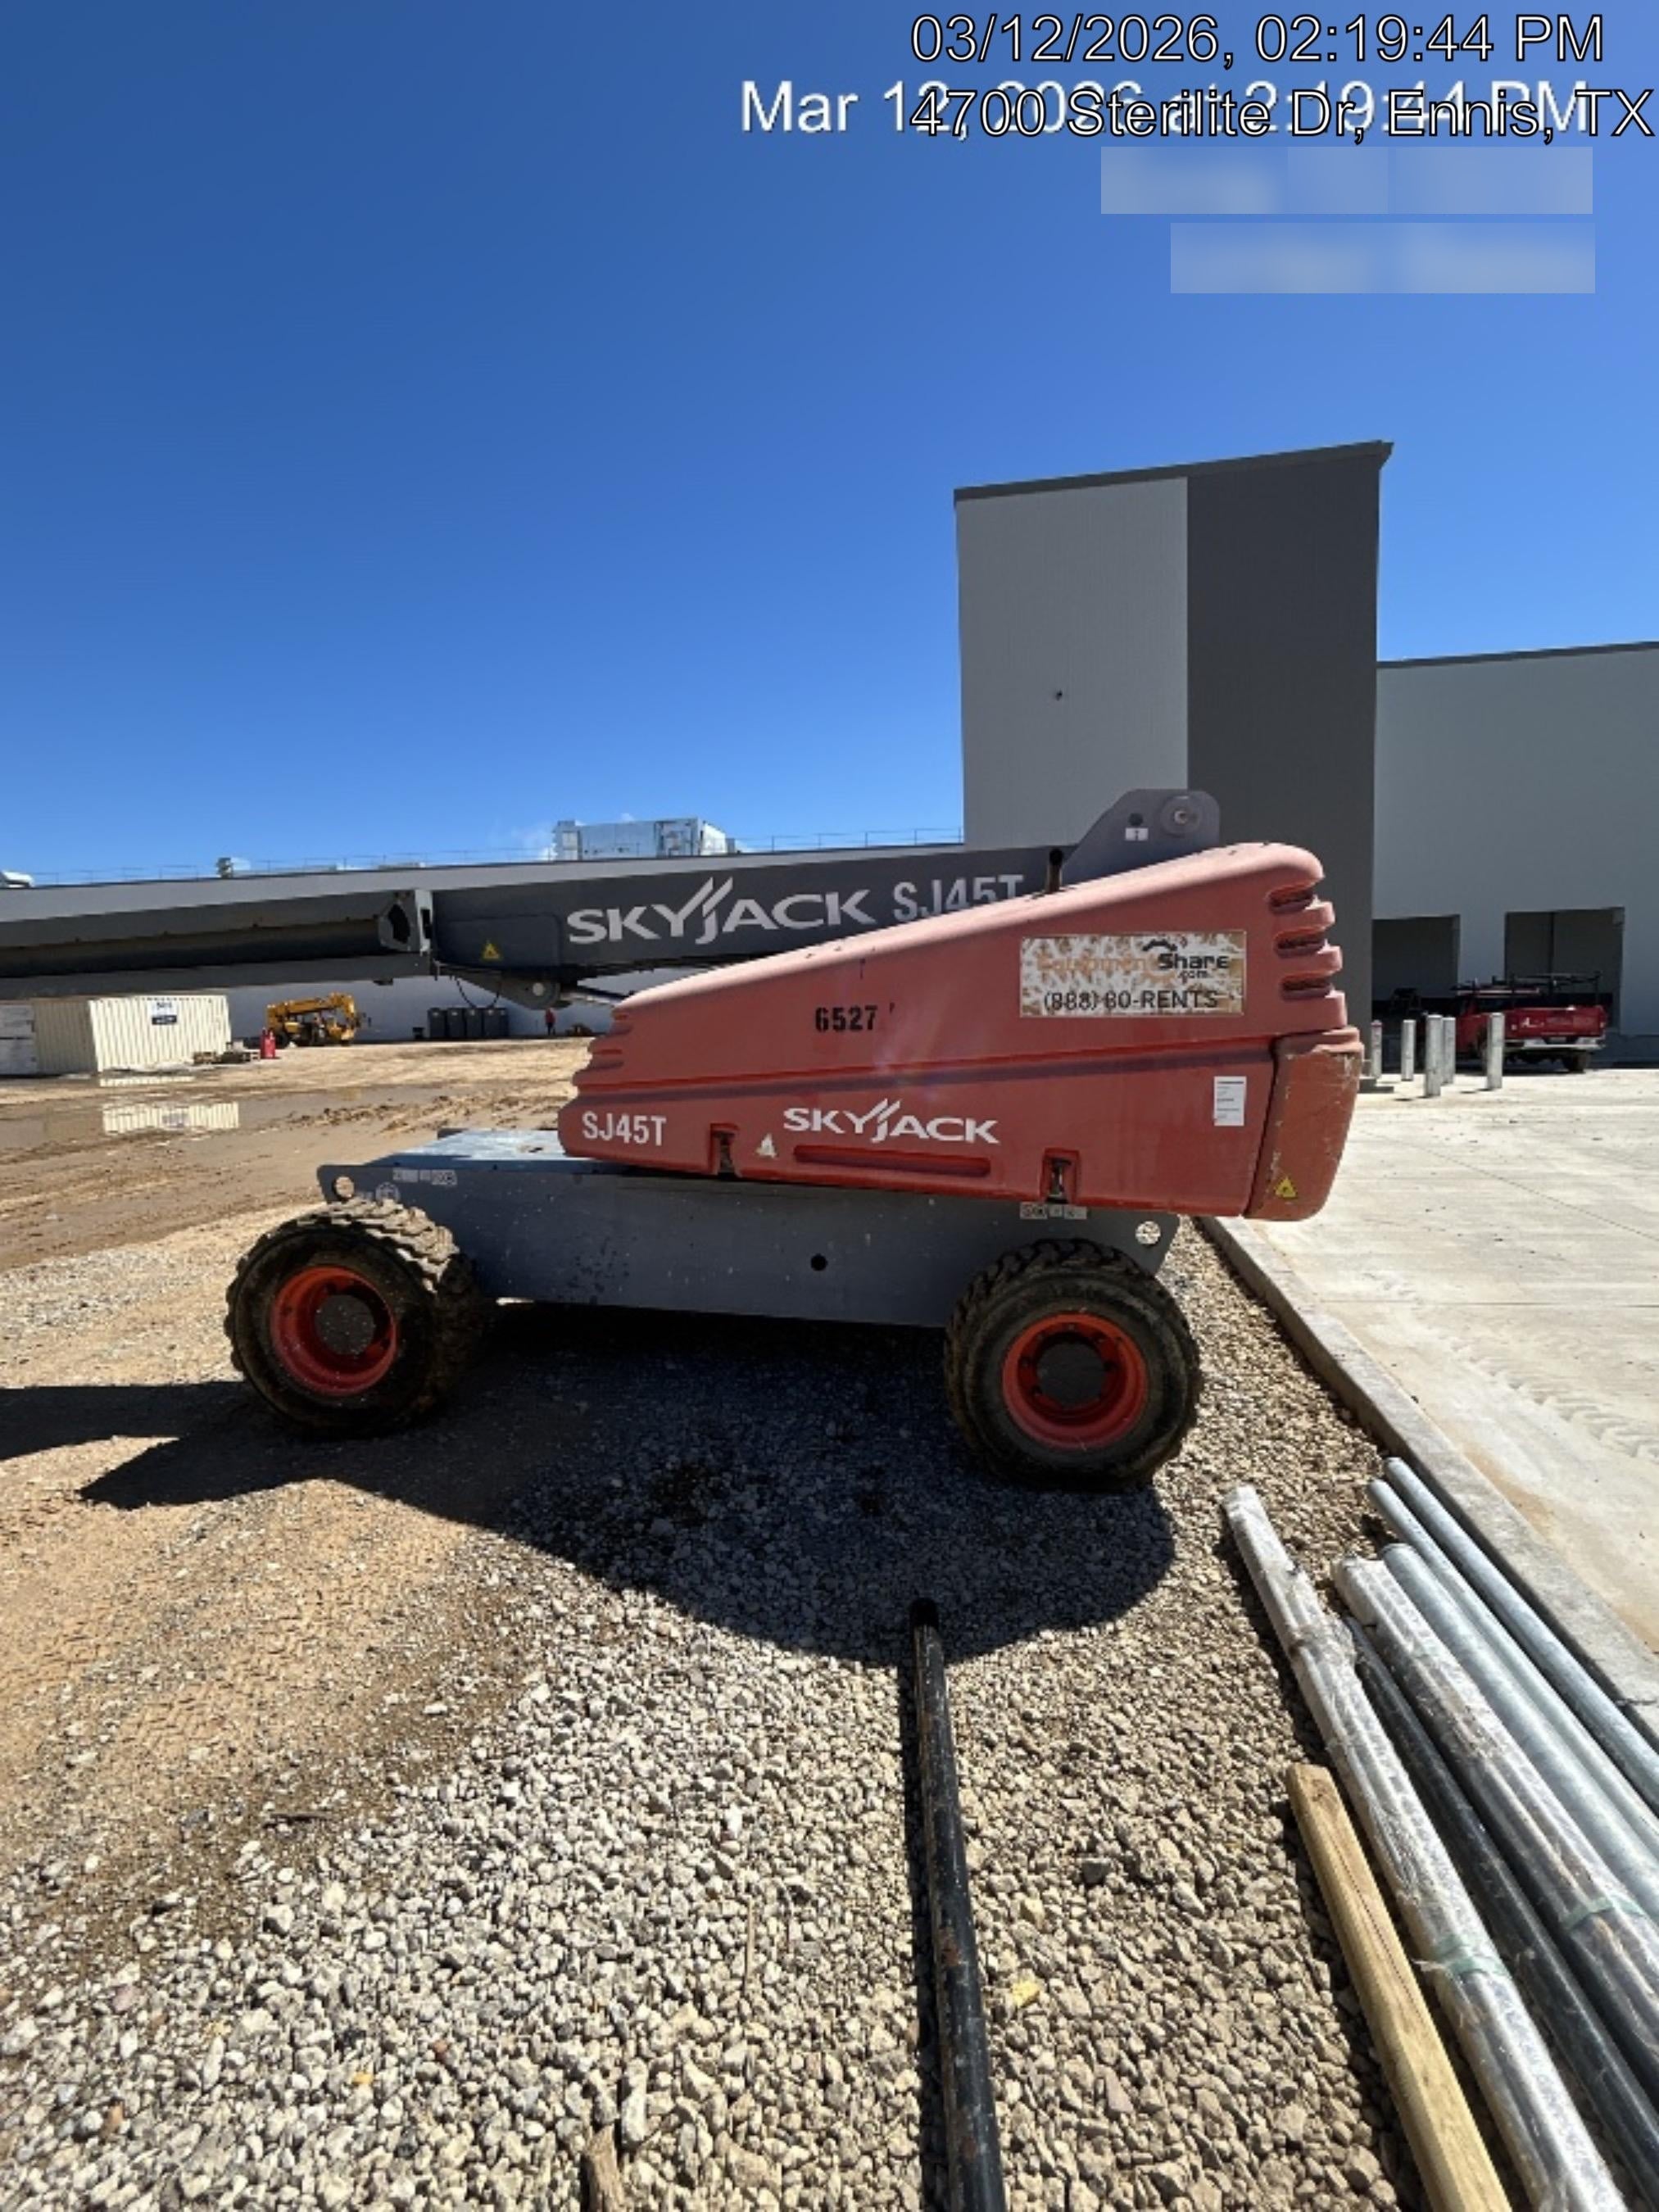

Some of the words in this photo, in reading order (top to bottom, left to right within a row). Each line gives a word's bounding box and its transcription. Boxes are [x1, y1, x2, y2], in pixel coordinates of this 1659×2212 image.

[566, 877, 877, 945] SKYJACK
[891, 873, 1024, 922] SJ45T
[814, 1004, 879, 1032] 6527
[582, 1112, 668, 1146] SJ45T
[783, 1099, 999, 1145] SKYJACK
